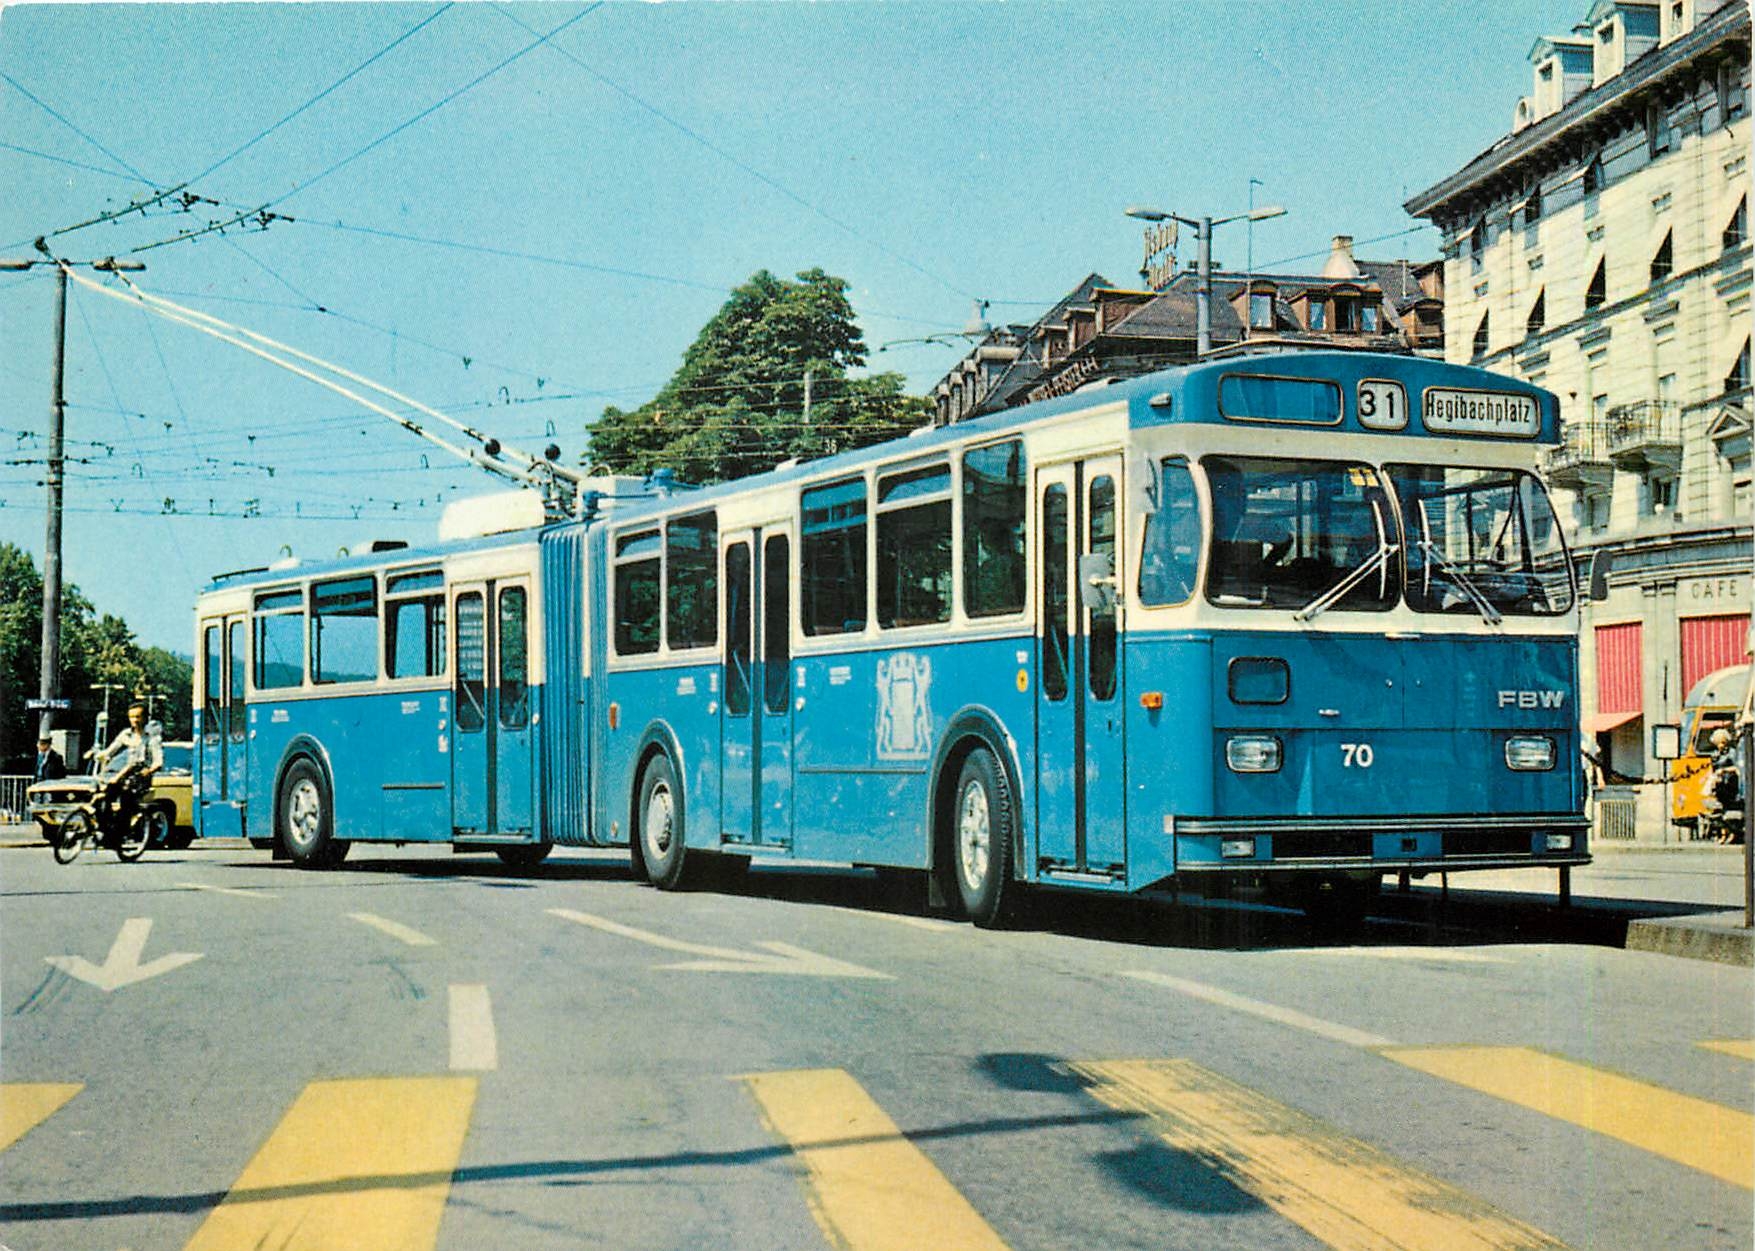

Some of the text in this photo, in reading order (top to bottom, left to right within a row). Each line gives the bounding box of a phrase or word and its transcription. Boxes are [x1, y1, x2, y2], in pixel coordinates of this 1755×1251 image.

[1360, 390, 1394, 419] 31
[1426, 393, 1530, 425] Hegibachplatz
[1498, 690, 1565, 709] FBW
[1340, 743, 1374, 768] 70
